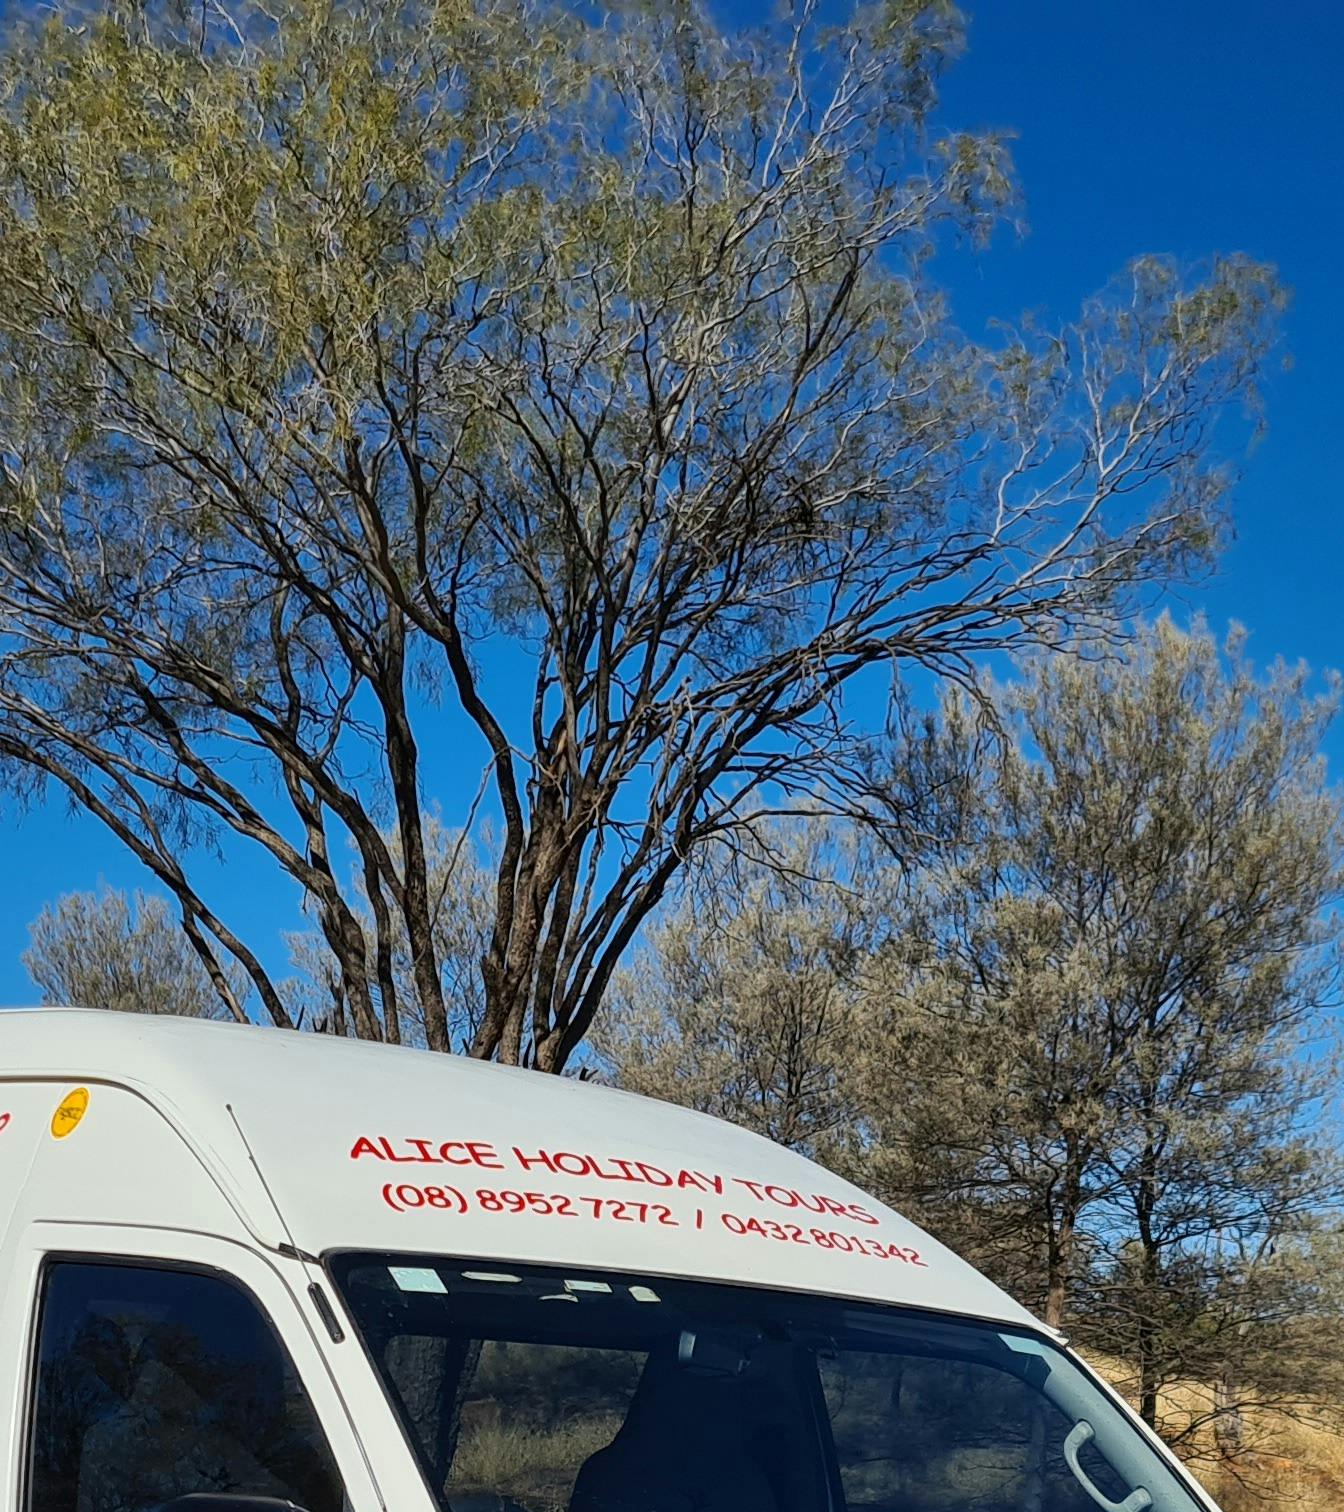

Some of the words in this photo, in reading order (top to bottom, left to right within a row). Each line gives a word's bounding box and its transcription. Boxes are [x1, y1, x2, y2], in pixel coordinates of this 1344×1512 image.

[350, 1136, 505, 1169] ALICE
[512, 1146, 723, 1194] HOLIDAY
[732, 1177, 881, 1225] TOURS
[382, 1183, 469, 1213] (08)
